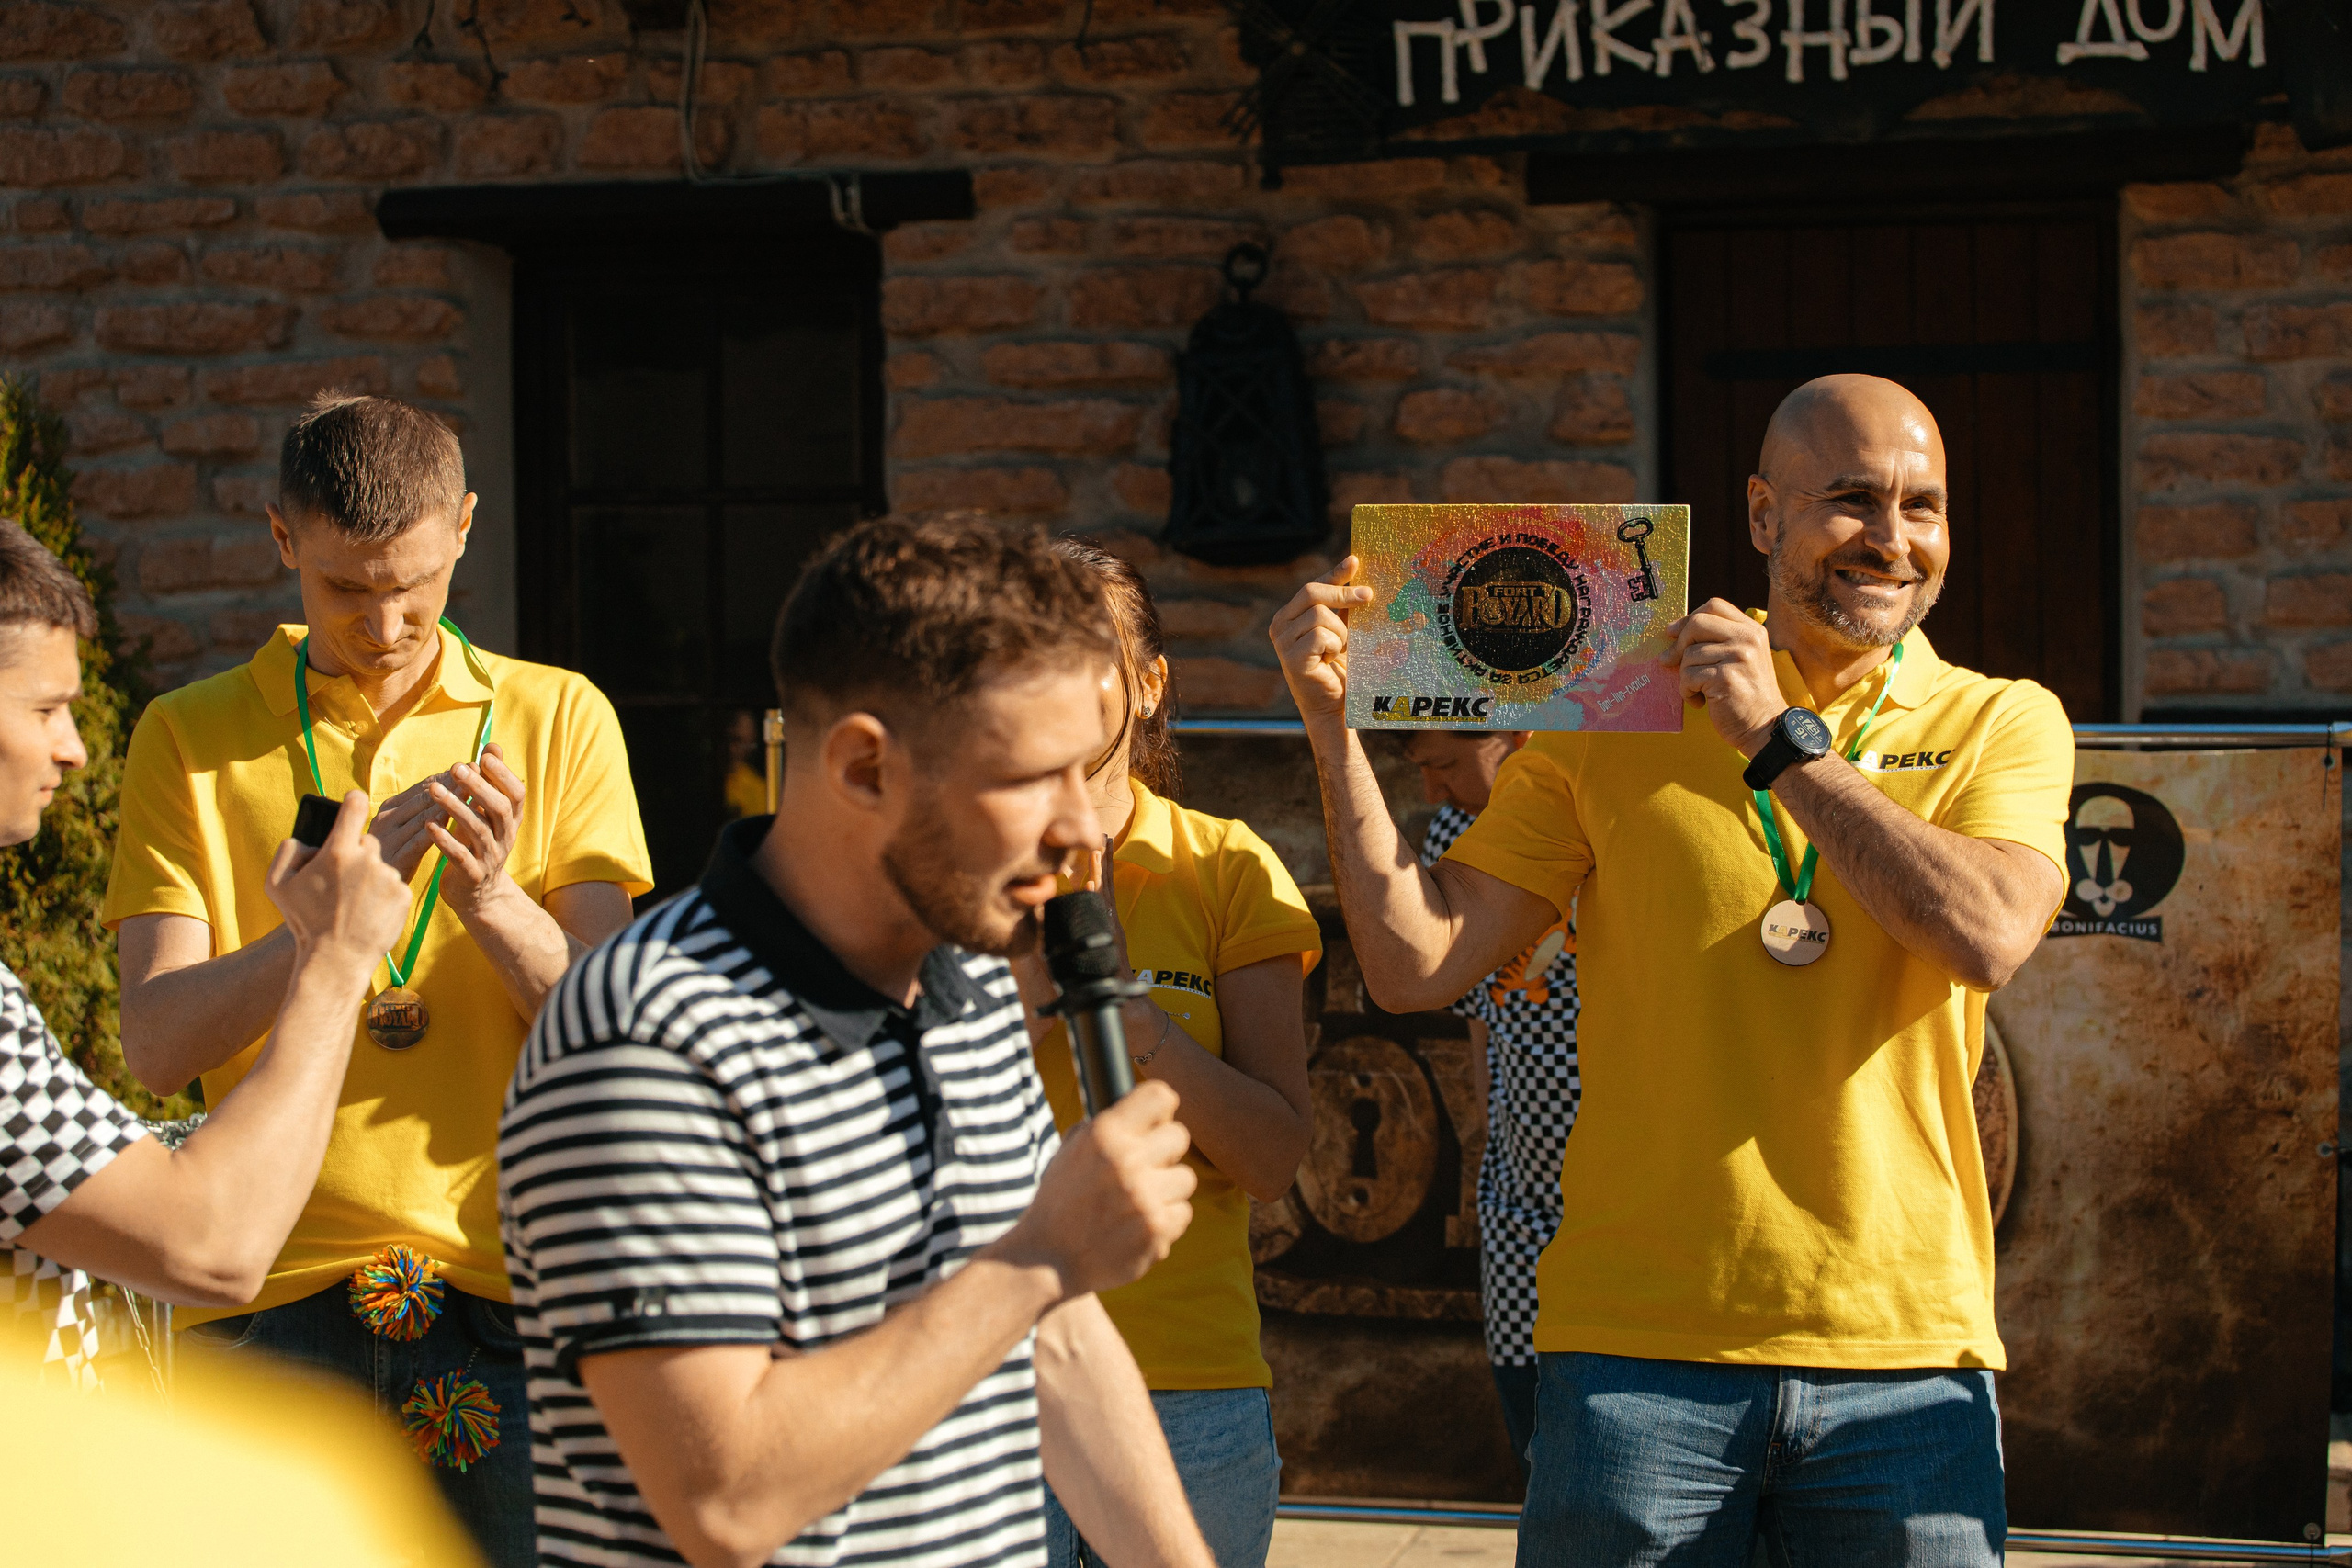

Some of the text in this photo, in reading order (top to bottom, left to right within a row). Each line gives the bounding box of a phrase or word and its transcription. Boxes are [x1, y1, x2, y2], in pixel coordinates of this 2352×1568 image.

[2056, 0, 2266, 72] ДОМ
[1499, 533, 1511, 545] И
[1517, 533, 1580, 570] ПОБЕДУ
[1493, 587, 1538, 597] FORT
[1373, 696, 1490, 717] КАРЕКС
[1794, 727, 1808, 739] 16
[1768, 923, 1827, 942] КАРЕКС
[1132, 969, 1212, 996] АРЕКС
